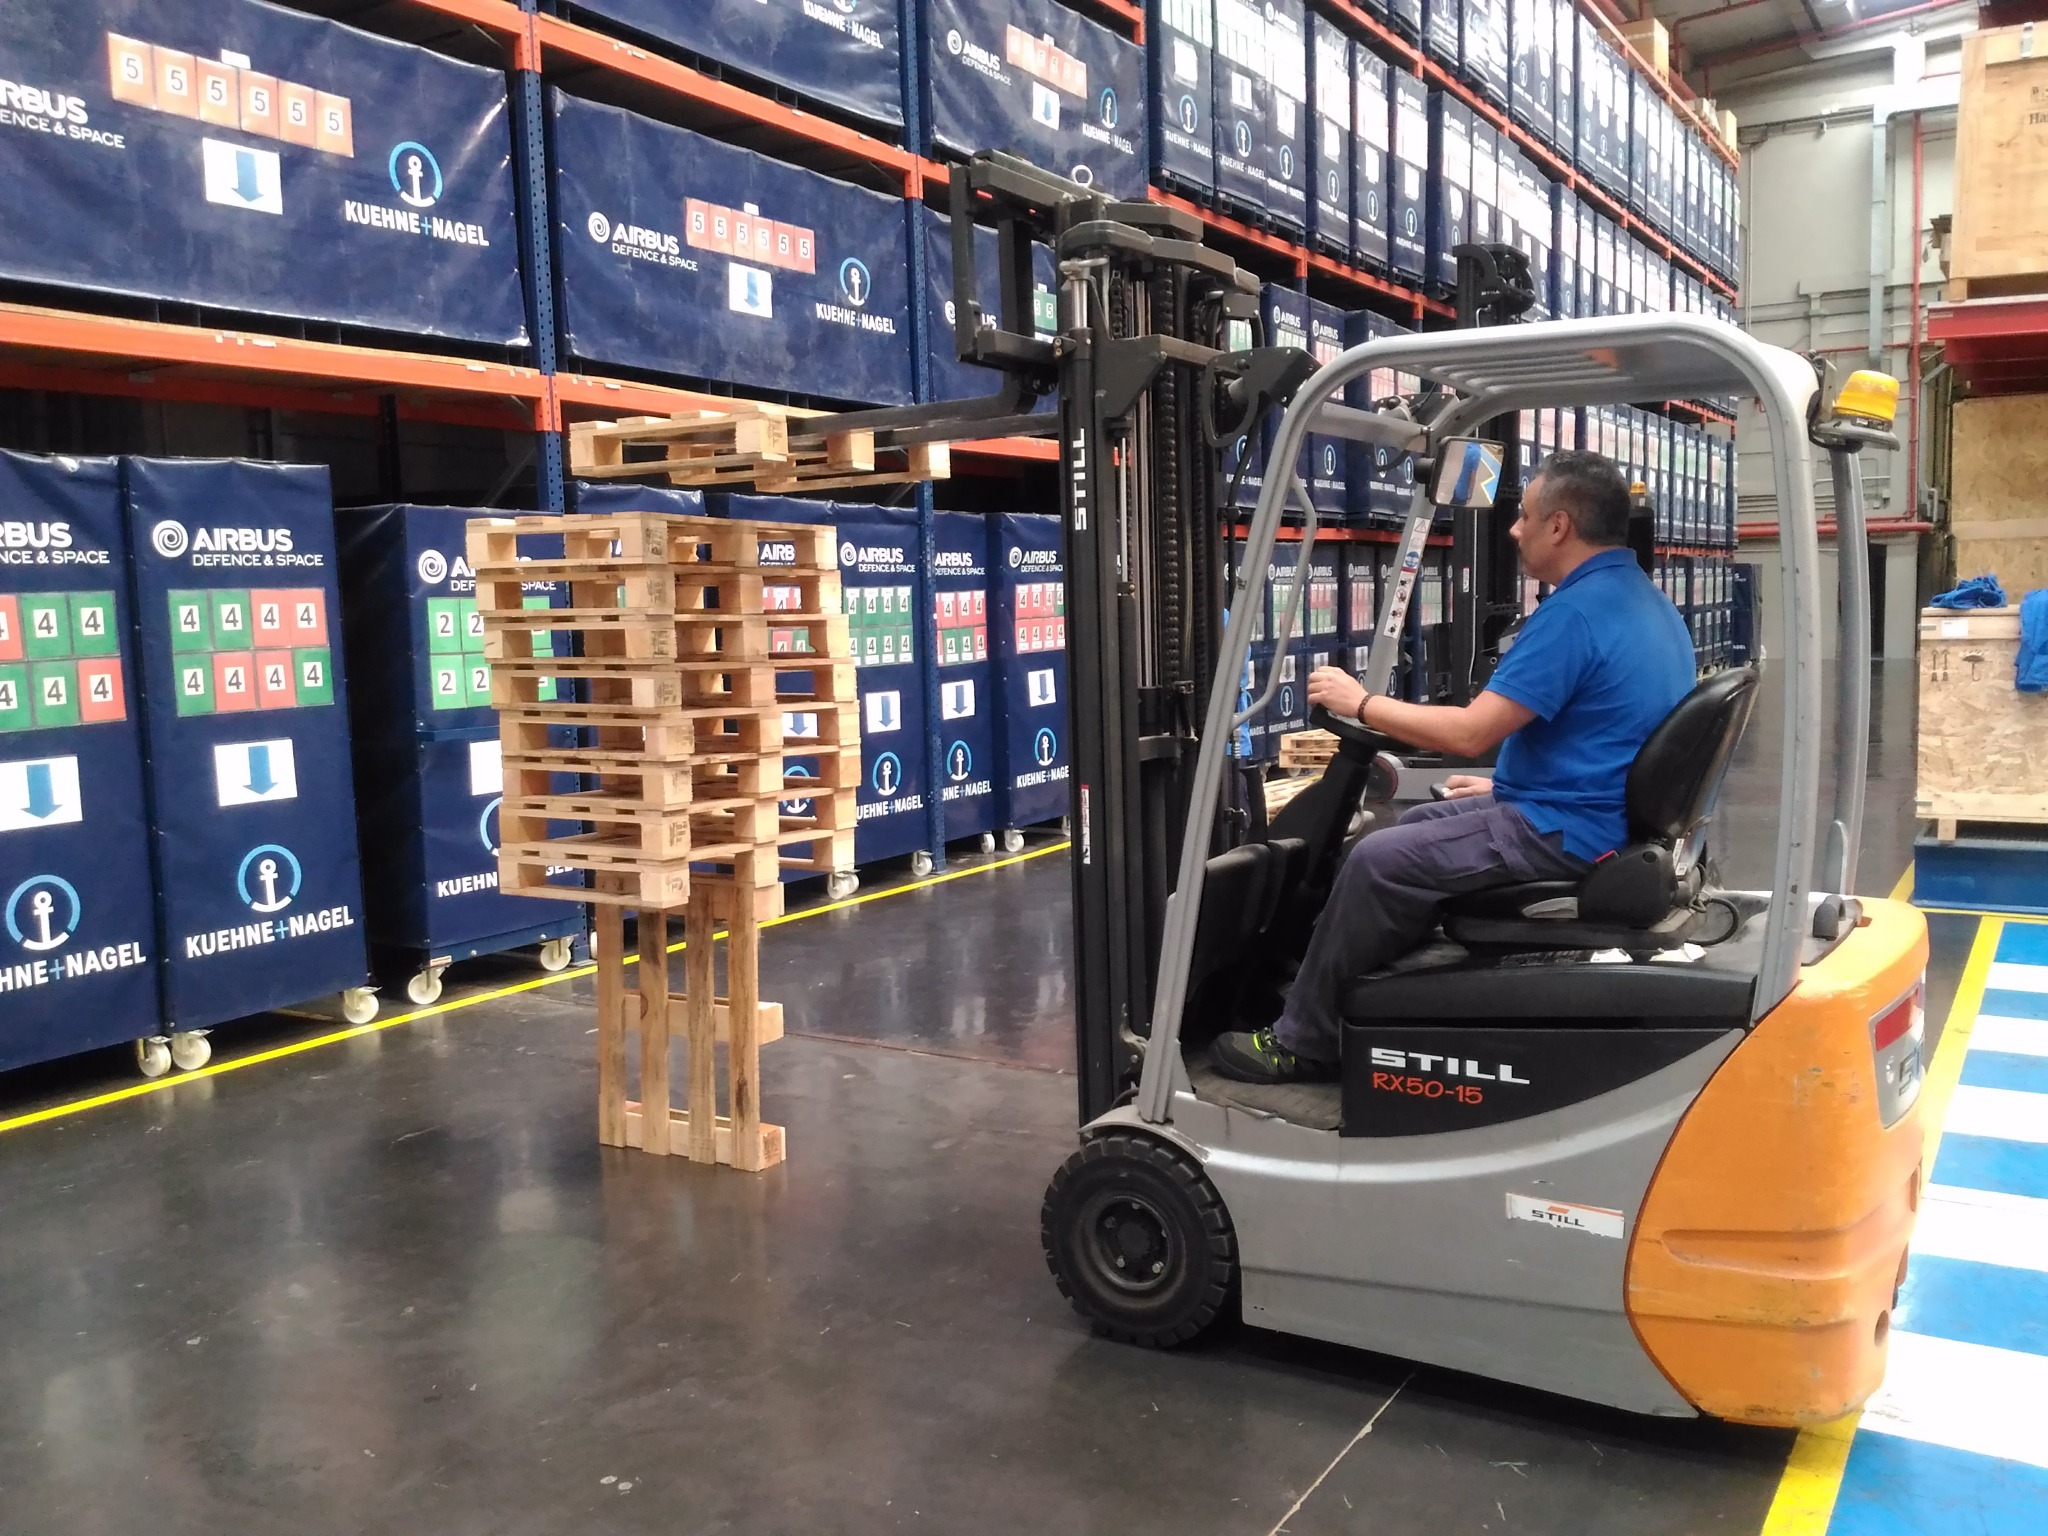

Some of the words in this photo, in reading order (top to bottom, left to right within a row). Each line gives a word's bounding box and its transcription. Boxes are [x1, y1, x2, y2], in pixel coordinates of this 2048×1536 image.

[803, 1, 884, 49] KUEHNE+NAGEL
[126, 57, 139, 79] 5
[171, 69, 184, 91] 5
[211, 80, 223, 102] 5
[254, 91, 266, 113] 5
[292, 102, 304, 123] 5
[328, 111, 340, 132] 5
[53, 121, 67, 136] &
[69, 124, 126, 149] SPACE
[345, 200, 490, 248] KUEHNE+NAGEL
[695, 214, 703, 230] 5
[717, 220, 725, 236] 5
[739, 225, 746, 241] 5
[761, 231, 768, 246] 5
[780, 236, 787, 252] 5
[802, 241, 809, 256] 5
[612, 222, 680, 255] AIRBUS
[612, 243, 661, 263] DEFENCE
[661, 254, 668, 266] &
[668, 255, 698, 272] SPACE
[815, 302, 896, 335] KUEHNE+NAGEL
[1073, 428, 1087, 531] STILL
[192, 528, 294, 552] AIRBUS
[760, 543, 795, 561] AIRB
[37, 550, 49, 564] &
[52, 550, 110, 565] SPACE
[192, 553, 263, 567] DEFENCE
[263, 553, 274, 567] &
[277, 553, 324, 567] SPACE
[858, 547, 904, 563] AIRBUS
[935, 552, 973, 567] AIRBUS
[1021, 550, 1057, 564] AIRBUS
[858, 564, 890, 573] DEFENCE
[896, 564, 916, 573] SPACE
[966, 567, 985, 575] SPACE
[183, 608, 197, 629] 4
[224, 606, 239, 627] 4
[264, 606, 277, 626] 4
[300, 605, 313, 625] 4
[849, 599, 856, 612] 4
[868, 598, 875, 612] 4
[885, 598, 891, 610] 4
[901, 598, 907, 610] 4
[945, 603, 951, 615] 4
[962, 602, 968, 614] 4
[976, 600, 982, 612] 4
[38, 612, 54, 635] 4
[84, 609, 101, 633] 4
[440, 614, 451, 634] 2
[471, 614, 482, 634] 2
[850, 640, 856, 652] 4
[868, 639, 875, 651] 4
[885, 637, 891, 650] 4
[902, 636, 909, 649] 4
[947, 639, 954, 651] 4
[964, 637, 970, 650] 4
[978, 636, 984, 648] 4
[187, 671, 201, 692] 4
[228, 669, 242, 690] 4
[269, 667, 283, 687] 4
[306, 664, 320, 684] 4
[441, 672, 453, 691] 2
[475, 670, 487, 689] 2
[0, 683, 14, 707] 4
[47, 679, 63, 703] 4
[93, 677, 110, 700] 4
[1016, 764, 1070, 789] KUEHNE+NAGE
[942, 780, 992, 801] HNE+NAGEL
[856, 794, 924, 820] UEHNE+NAGEL
[186, 905, 354, 959] KUEHNE+NAGEL
[1371, 1047, 1531, 1085] STILL
[1372, 1071, 1483, 1105] RX50-15
[1531, 1209, 1585, 1227] STILL
